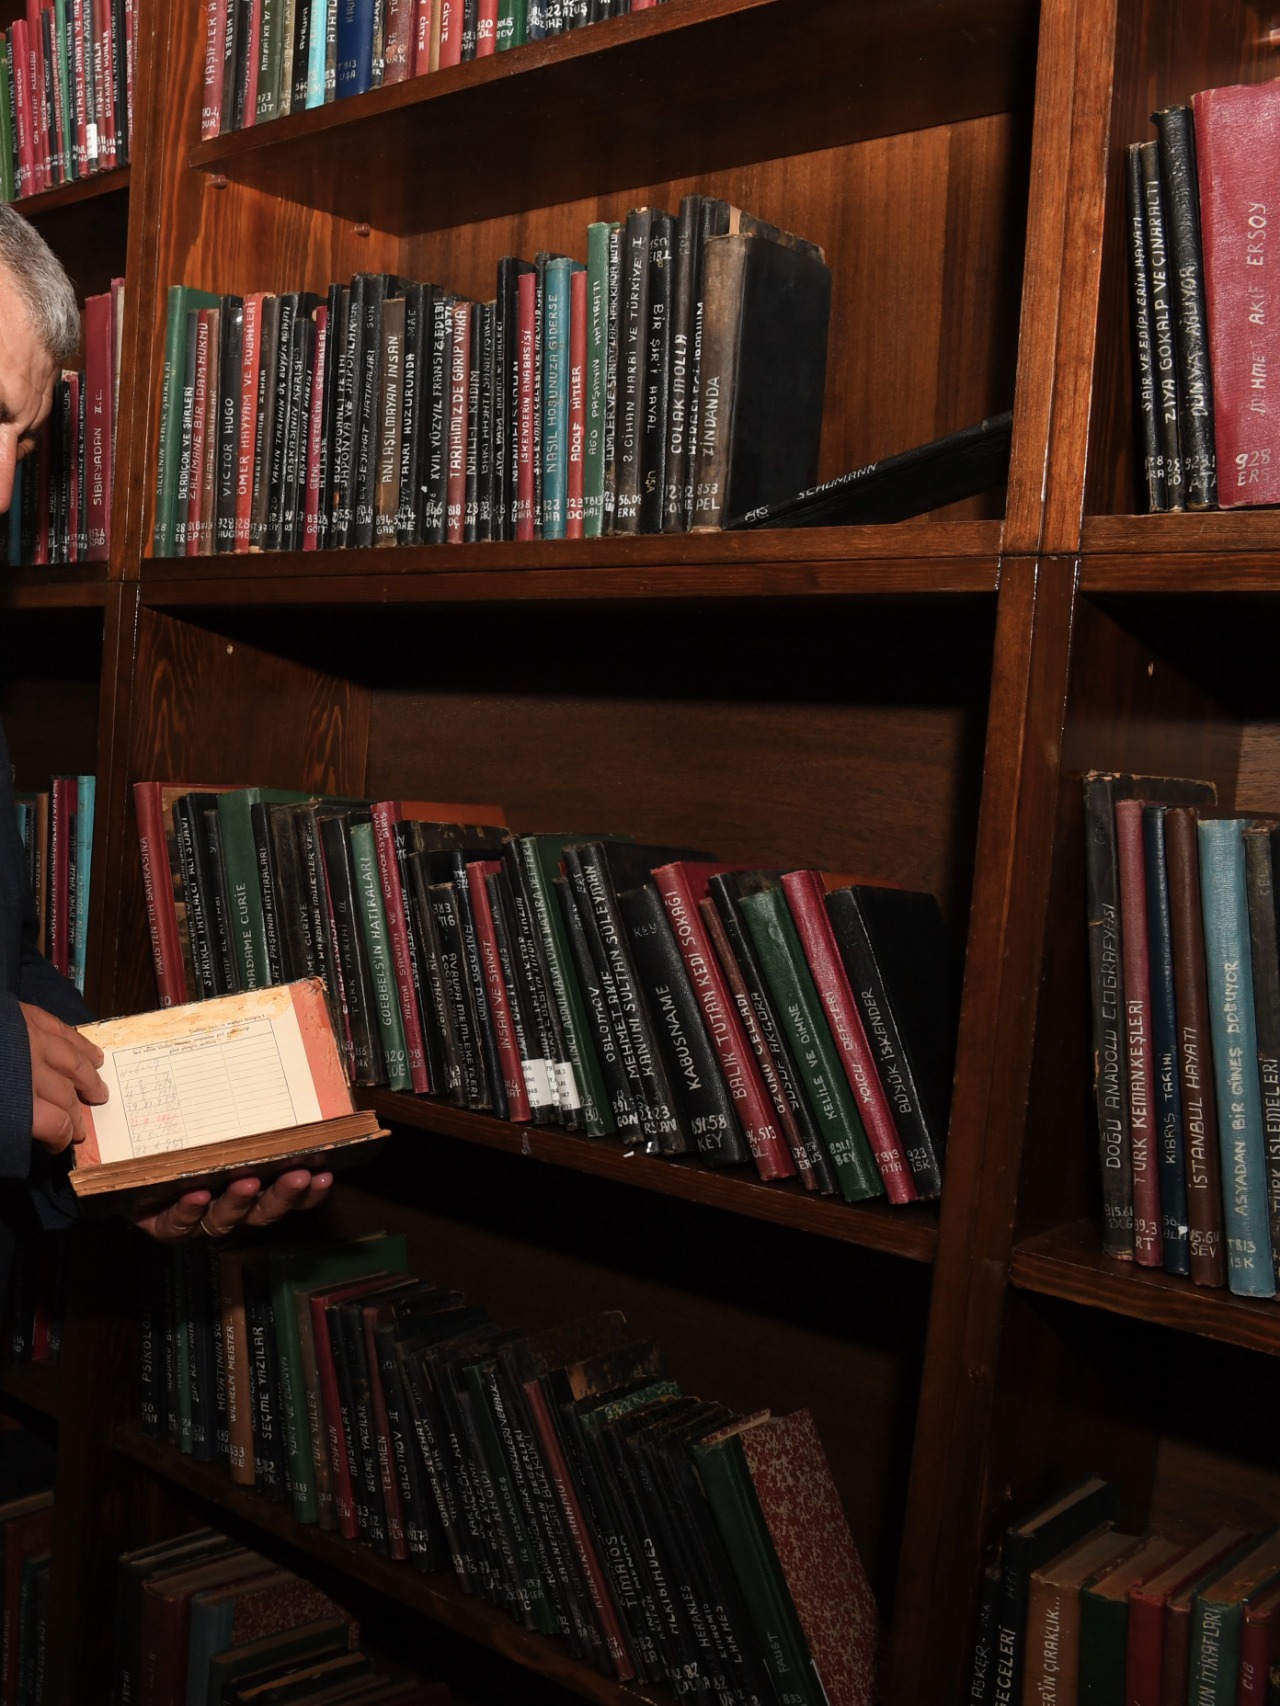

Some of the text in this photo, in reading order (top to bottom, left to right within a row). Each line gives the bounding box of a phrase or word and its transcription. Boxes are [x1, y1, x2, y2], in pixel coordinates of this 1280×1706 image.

[1131, 216, 1145, 268] HAYATI
[1146, 179, 1167, 293] VE ÇINARALTI
[1247, 201, 1268, 266] ERSOY
[629, 326, 637, 342] VE
[673, 334, 687, 393] MOLLA
[1138, 351, 1150, 370] VE
[243, 370, 252, 387] VE
[402, 353, 415, 435] HUZURUNDA
[625, 351, 637, 394] HARBİ
[240, 394, 252, 449] HAYYAM
[382, 334, 399, 484] ANLAŞILMAYAN İNSAN
[621, 401, 635, 447] CİHAN
[700, 376, 720, 457] ZİNDANDA
[182, 433, 190, 446] VE
[221, 397, 234, 497] VICTOR HUGO
[546, 430, 559, 473] NASIL
[569, 421, 582, 462] ADOLF
[589, 429, 598, 455] AGO
[1235, 448, 1271, 470] 928
[237, 456, 249, 496] ÖMER
[696, 498, 720, 511] PEL
[697, 483, 719, 494] 853
[796, 462, 879, 500] SCHUMANN
[617, 508, 636, 517] ERK
[139, 835, 154, 901] SAHRASINA
[359, 856, 381, 939] HATIRALARI
[388, 910, 397, 924] VE
[533, 891, 553, 935] HATIRA
[583, 864, 618, 944] SÜLEYMAN
[242, 929, 257, 988] MADAME
[610, 948, 636, 1012] SULTAN
[482, 939, 512, 1050] İNSAN VE SANAT
[664, 890, 748, 1100] BALIK TUTAN KEDİ SOKAĞI
[588, 986, 617, 1063] OBLOMOV
[613, 1008, 639, 1079] MEHMET
[655, 983, 703, 1091] KABUSNAME
[824, 989, 873, 1103] YOLCU DEFTERİ
[861, 985, 912, 1114] BÜYÜK İSKENDER
[775, 1059, 800, 1110] YUSUF
[788, 1002, 838, 1120] KELİLE VE DİMNE
[1103, 1029, 1121, 1109] ANADOLU
[1125, 1000, 1147, 1128] KEMANKEŞLERİ
[1183, 1026, 1207, 1188] İSTANBUL HAYATI
[1230, 1103, 1246, 1130] BİR
[697, 1131, 723, 1151] KEY
[907, 1147, 927, 1161] 923
[1103, 1118, 1122, 1169] DOĞU
[1164, 1113, 1176, 1164] KIBRIS
[1234, 1140, 1248, 1216] ASYADAN
[252, 1326, 274, 1440] SEÇME YAZILAR
[328, 1424, 340, 1473] TAYFUN
[340, 1406, 358, 1477] MASALLAR
[392, 1430, 412, 1500] OBLOMOV
[679, 1584, 710, 1648] HERAKLES
[766, 1631, 791, 1673] FAUST
